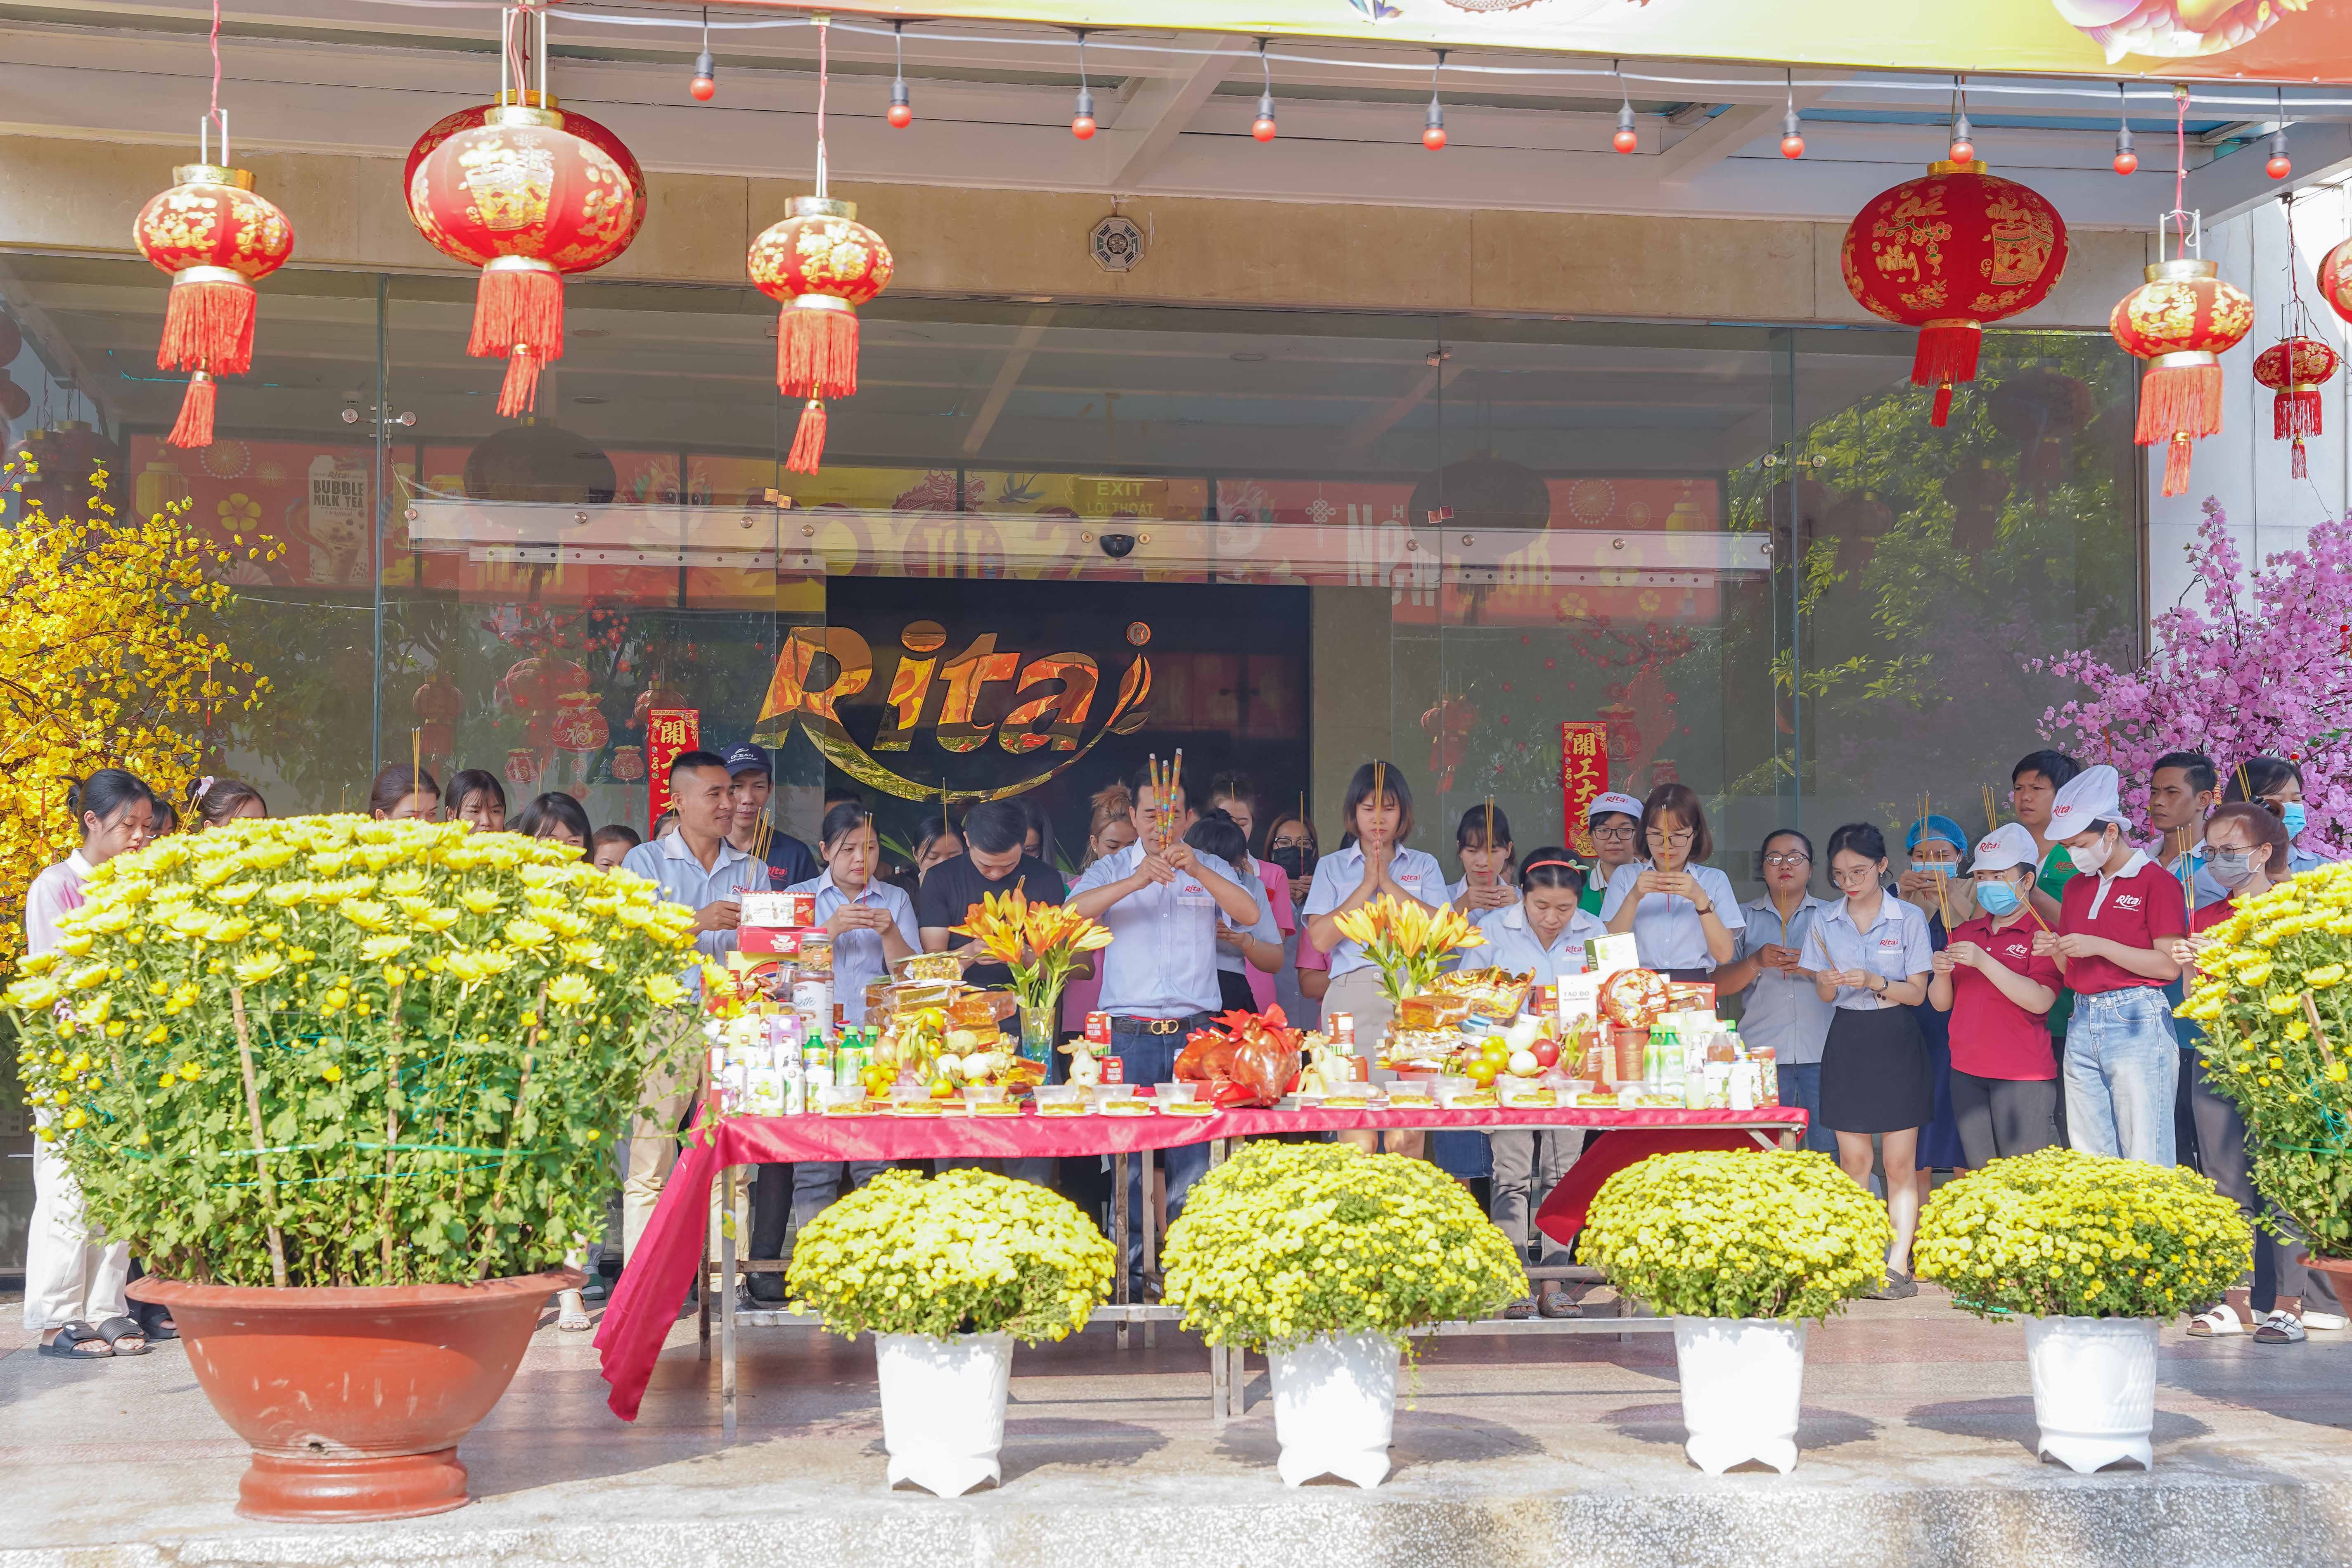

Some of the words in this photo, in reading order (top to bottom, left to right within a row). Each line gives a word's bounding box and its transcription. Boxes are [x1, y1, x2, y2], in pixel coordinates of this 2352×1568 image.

[314, 479, 363, 496] BUBBLE
[1097, 482, 1144, 496] EXIT
[314, 494, 340, 507] MILK
[344, 496, 363, 508] TEA
[749, 620, 1100, 760] Rita
[566, 721, 593, 746] 福
[1605, 795, 1625, 803] Rita
[2053, 804, 2072, 817] Rita
[1979, 841, 1998, 853] Rita
[2054, 861, 2074, 872] Rita
[1185, 885, 1201, 893] Rita
[2115, 894, 2140, 908] Rita
[1566, 945, 1583, 955] Rita
[2005, 943, 2028, 956] Rita
